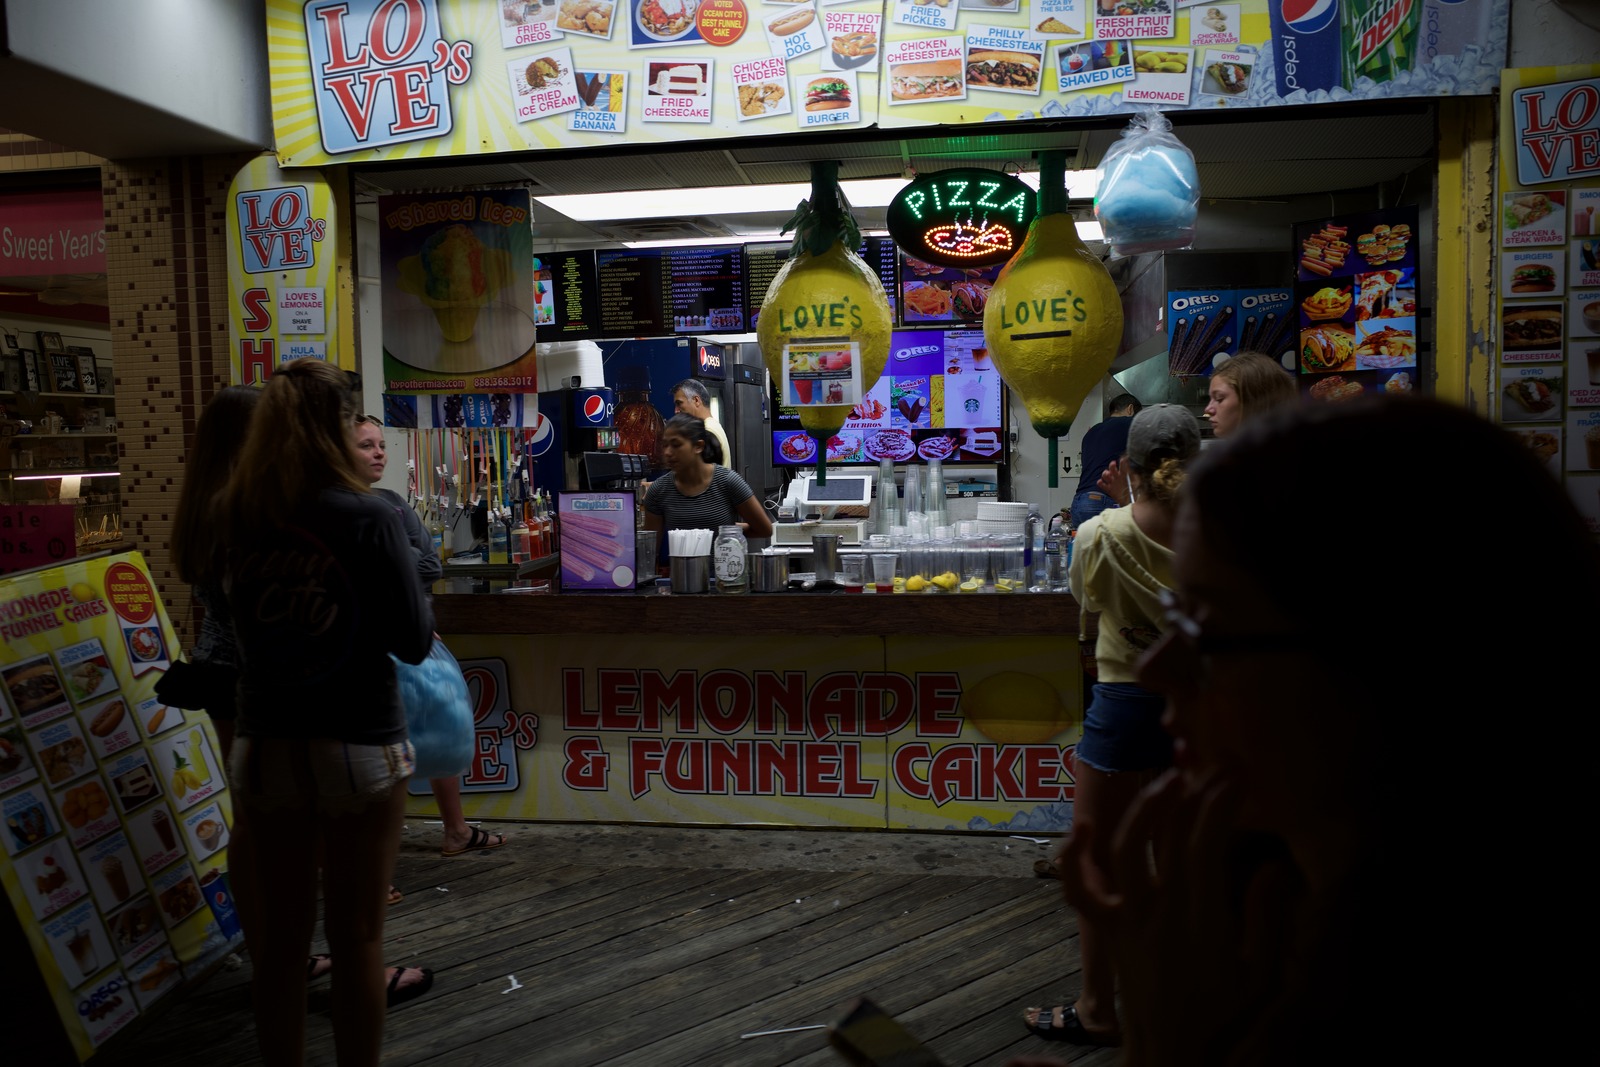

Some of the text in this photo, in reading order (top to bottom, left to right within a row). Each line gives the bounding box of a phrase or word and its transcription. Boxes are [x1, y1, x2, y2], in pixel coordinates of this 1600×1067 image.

[703, 10, 723, 18] OCEAN
[910, 6, 941, 17] FRIED
[718, 20, 742, 28] FUNNEL
[826, 13, 881, 24] SOFT HOT
[902, 14, 946, 27] PICKLES
[1095, 16, 1172, 28] FRESH FRUIT
[517, 22, 547, 35] FRIED
[713, 28, 730, 36] CAKE
[827, 23, 877, 34] PRETZEL
[988, 28, 1024, 39] PHILLY
[1098, 26, 1168, 38] SMOOTHIES
[515, 31, 551, 44] OREOS
[784, 32, 807, 47] HOT
[967, 36, 1043, 51] CHEESESTEAK
[786, 41, 812, 58] DOG
[900, 40, 947, 52] CHICKEN
[887, 48, 962, 62] CHEESESTEAK
[1281, 34, 1299, 89] pepsi
[733, 57, 784, 74] CHICKEN
[734, 67, 786, 84] TENDERS
[1060, 66, 1133, 88] SHAVED ICE
[530, 89, 562, 105] FRIED
[1127, 90, 1185, 100] LEMONADE
[519, 96, 577, 117] ICE CREAM
[661, 98, 693, 107] FRIED
[574, 112, 616, 122] FROZEN
[645, 108, 709, 118] CHEESECAKE
[807, 112, 849, 124] BURGER
[573, 120, 616, 130] BANANA
[905, 181, 1026, 222] PIZZA
[242, 191, 302, 231] LO
[1512, 230, 1549, 238] CHICKEN
[3, 226, 54, 261] Sweet
[1514, 252, 1553, 260] BURGERS
[285, 292, 317, 300] LOVE'S
[1172, 294, 1220, 311] OREO
[1241, 292, 1289, 309] OREO
[779, 296, 863, 332] LOVE'S
[1001, 289, 1087, 330] LOVE'S
[1189, 304, 1214, 315] Churros
[1258, 303, 1283, 313] Churros
[290, 346, 315, 354] HULA
[894, 344, 940, 362] OREO
[707, 354, 721, 369] pepsi
[1504, 353, 1561, 361] CHEESESTEAK
[1520, 368, 1543, 376] GYRO
[390, 376, 532, 389] hypothermias.com 888.368.3017
[467, 396, 475, 420] OREO
[117, 572, 136, 580] VOTED
[114, 594, 152, 604] BEST FUNNEL
[128, 604, 144, 612] CAKE
[256, 578, 339, 636] City
[1, 599, 108, 642] FUNNEL CAKES
[562, 667, 965, 743] LEMONADE
[562, 736, 611, 791] &
[628, 736, 879, 800] FUNNEL
[0, 776, 22, 790] GYRO
[188, 786, 214, 804] LEMONADE
[78, 980, 120, 1016] OREO
